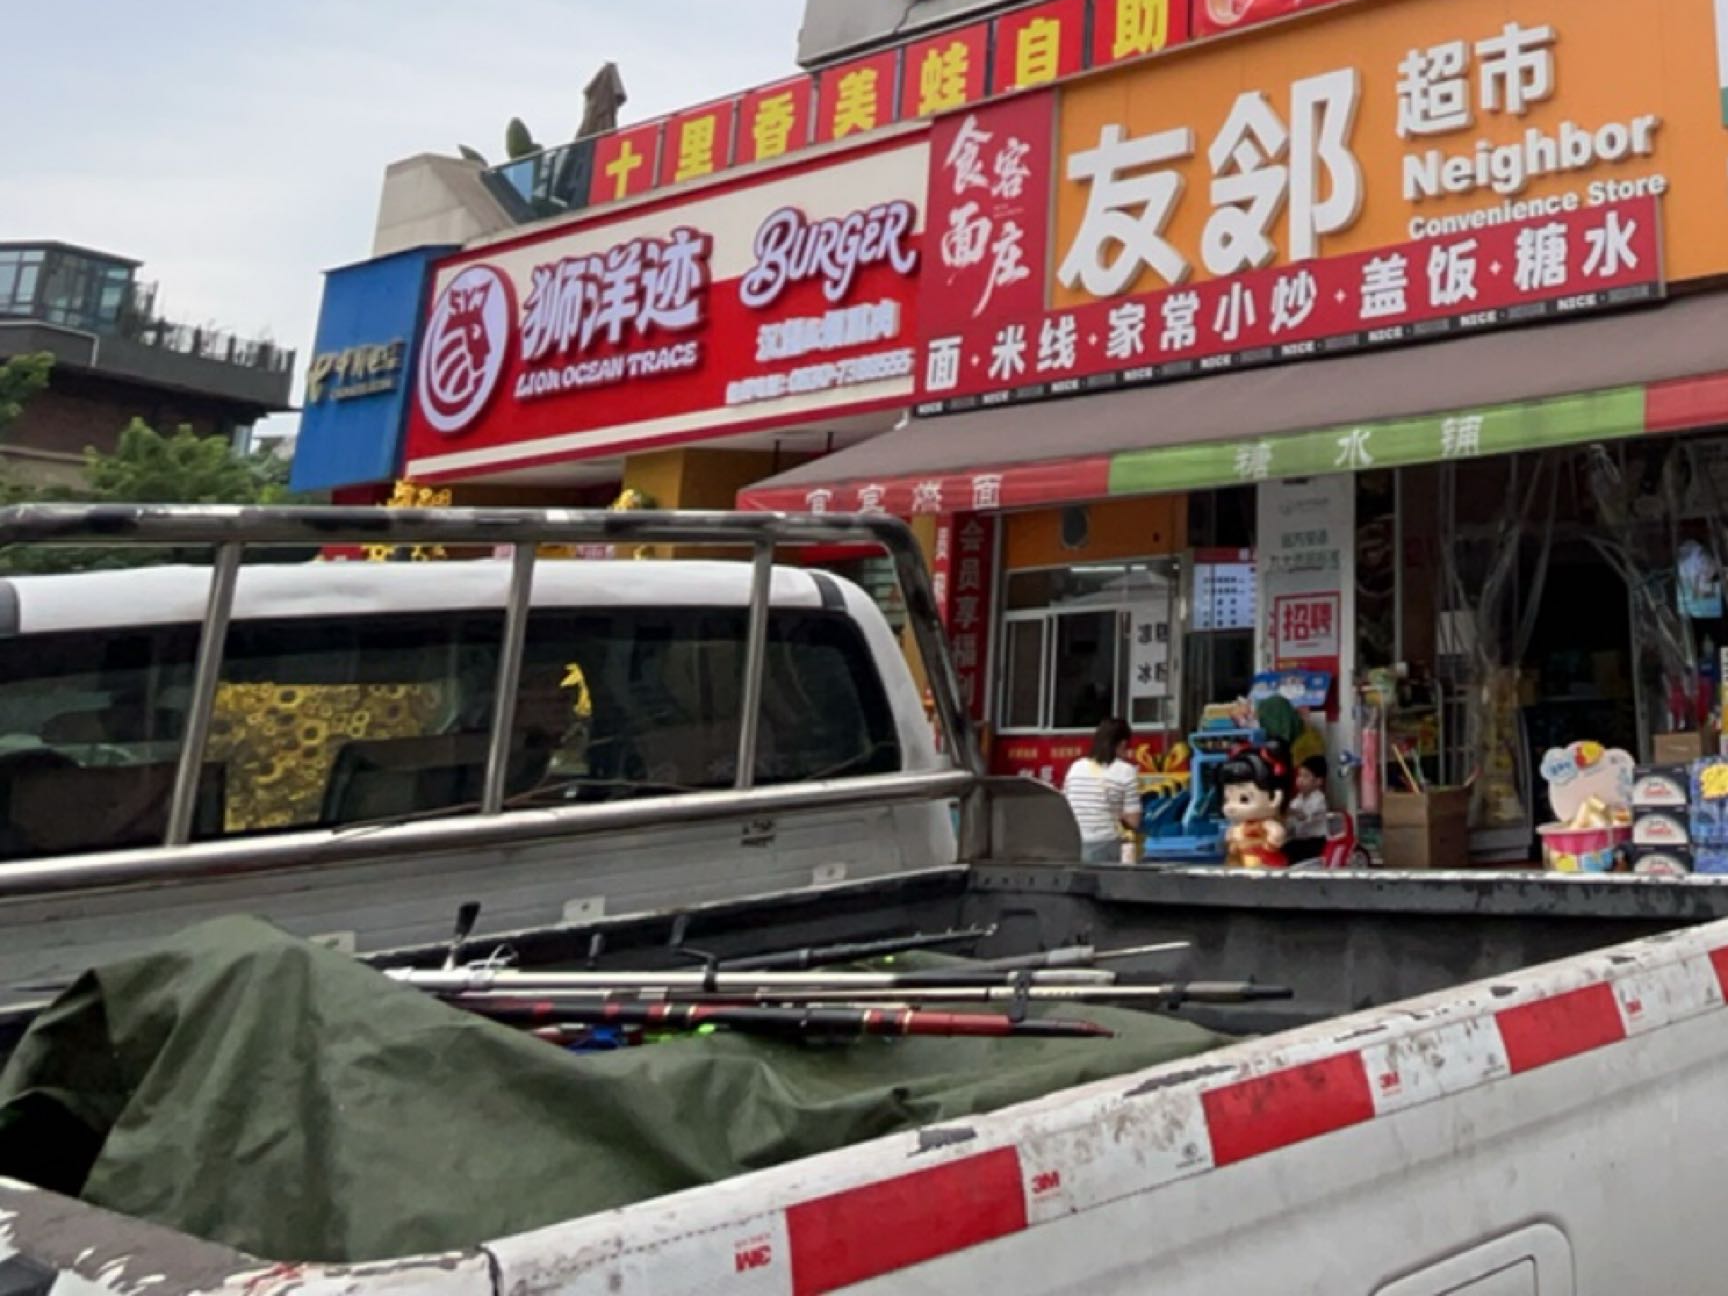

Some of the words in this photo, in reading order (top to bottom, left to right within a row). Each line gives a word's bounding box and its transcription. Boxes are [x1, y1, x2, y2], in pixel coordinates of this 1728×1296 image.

[1396, 20, 1557, 140] 超市
[1056, 65, 1365, 296] 友邻
[1403, 113, 1660, 200] Neighbor
[1408, 188, 1580, 241] Convenience
[1587, 171, 1667, 207] Store
[521, 226, 704, 361] 狮洋迹
[562, 355, 623, 391] OCEAN
[1031, 1170, 1061, 1194] 3M
